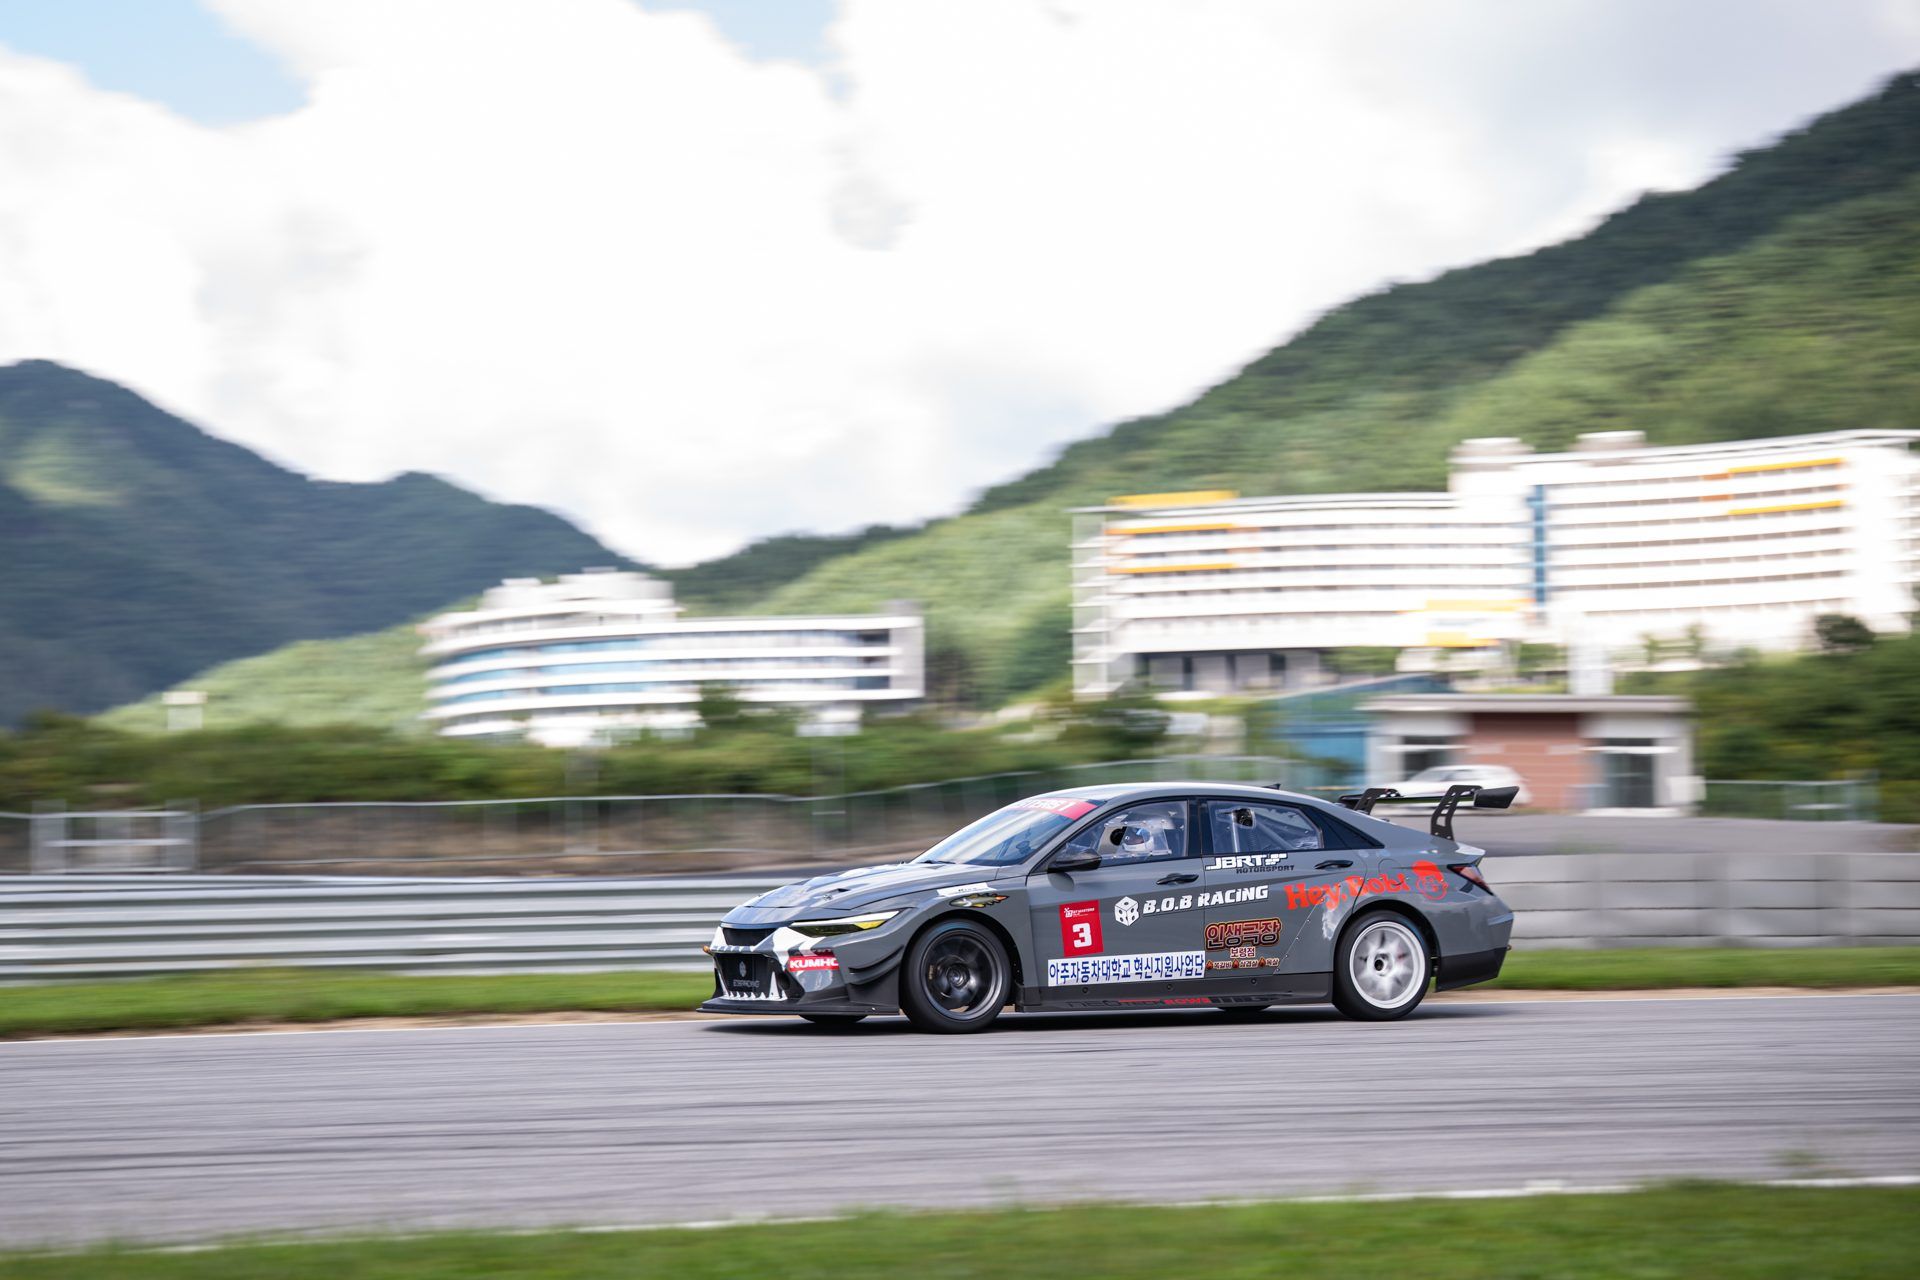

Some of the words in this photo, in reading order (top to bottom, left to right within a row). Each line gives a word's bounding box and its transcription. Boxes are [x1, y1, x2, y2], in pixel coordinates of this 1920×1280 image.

[1236, 865, 1295, 874] MOTORSPORT
[1142, 895, 1193, 914] B.O.B
[1197, 885, 1269, 907] RACING
[1072, 922, 1092, 948] 3
[1206, 919, 1282, 950] 인생극장
[1230, 948, 1255, 957] 보령점
[1049, 958, 1131, 985] 아주자동차대학교
[1133, 954, 1205, 979] 혁신지원사업단
